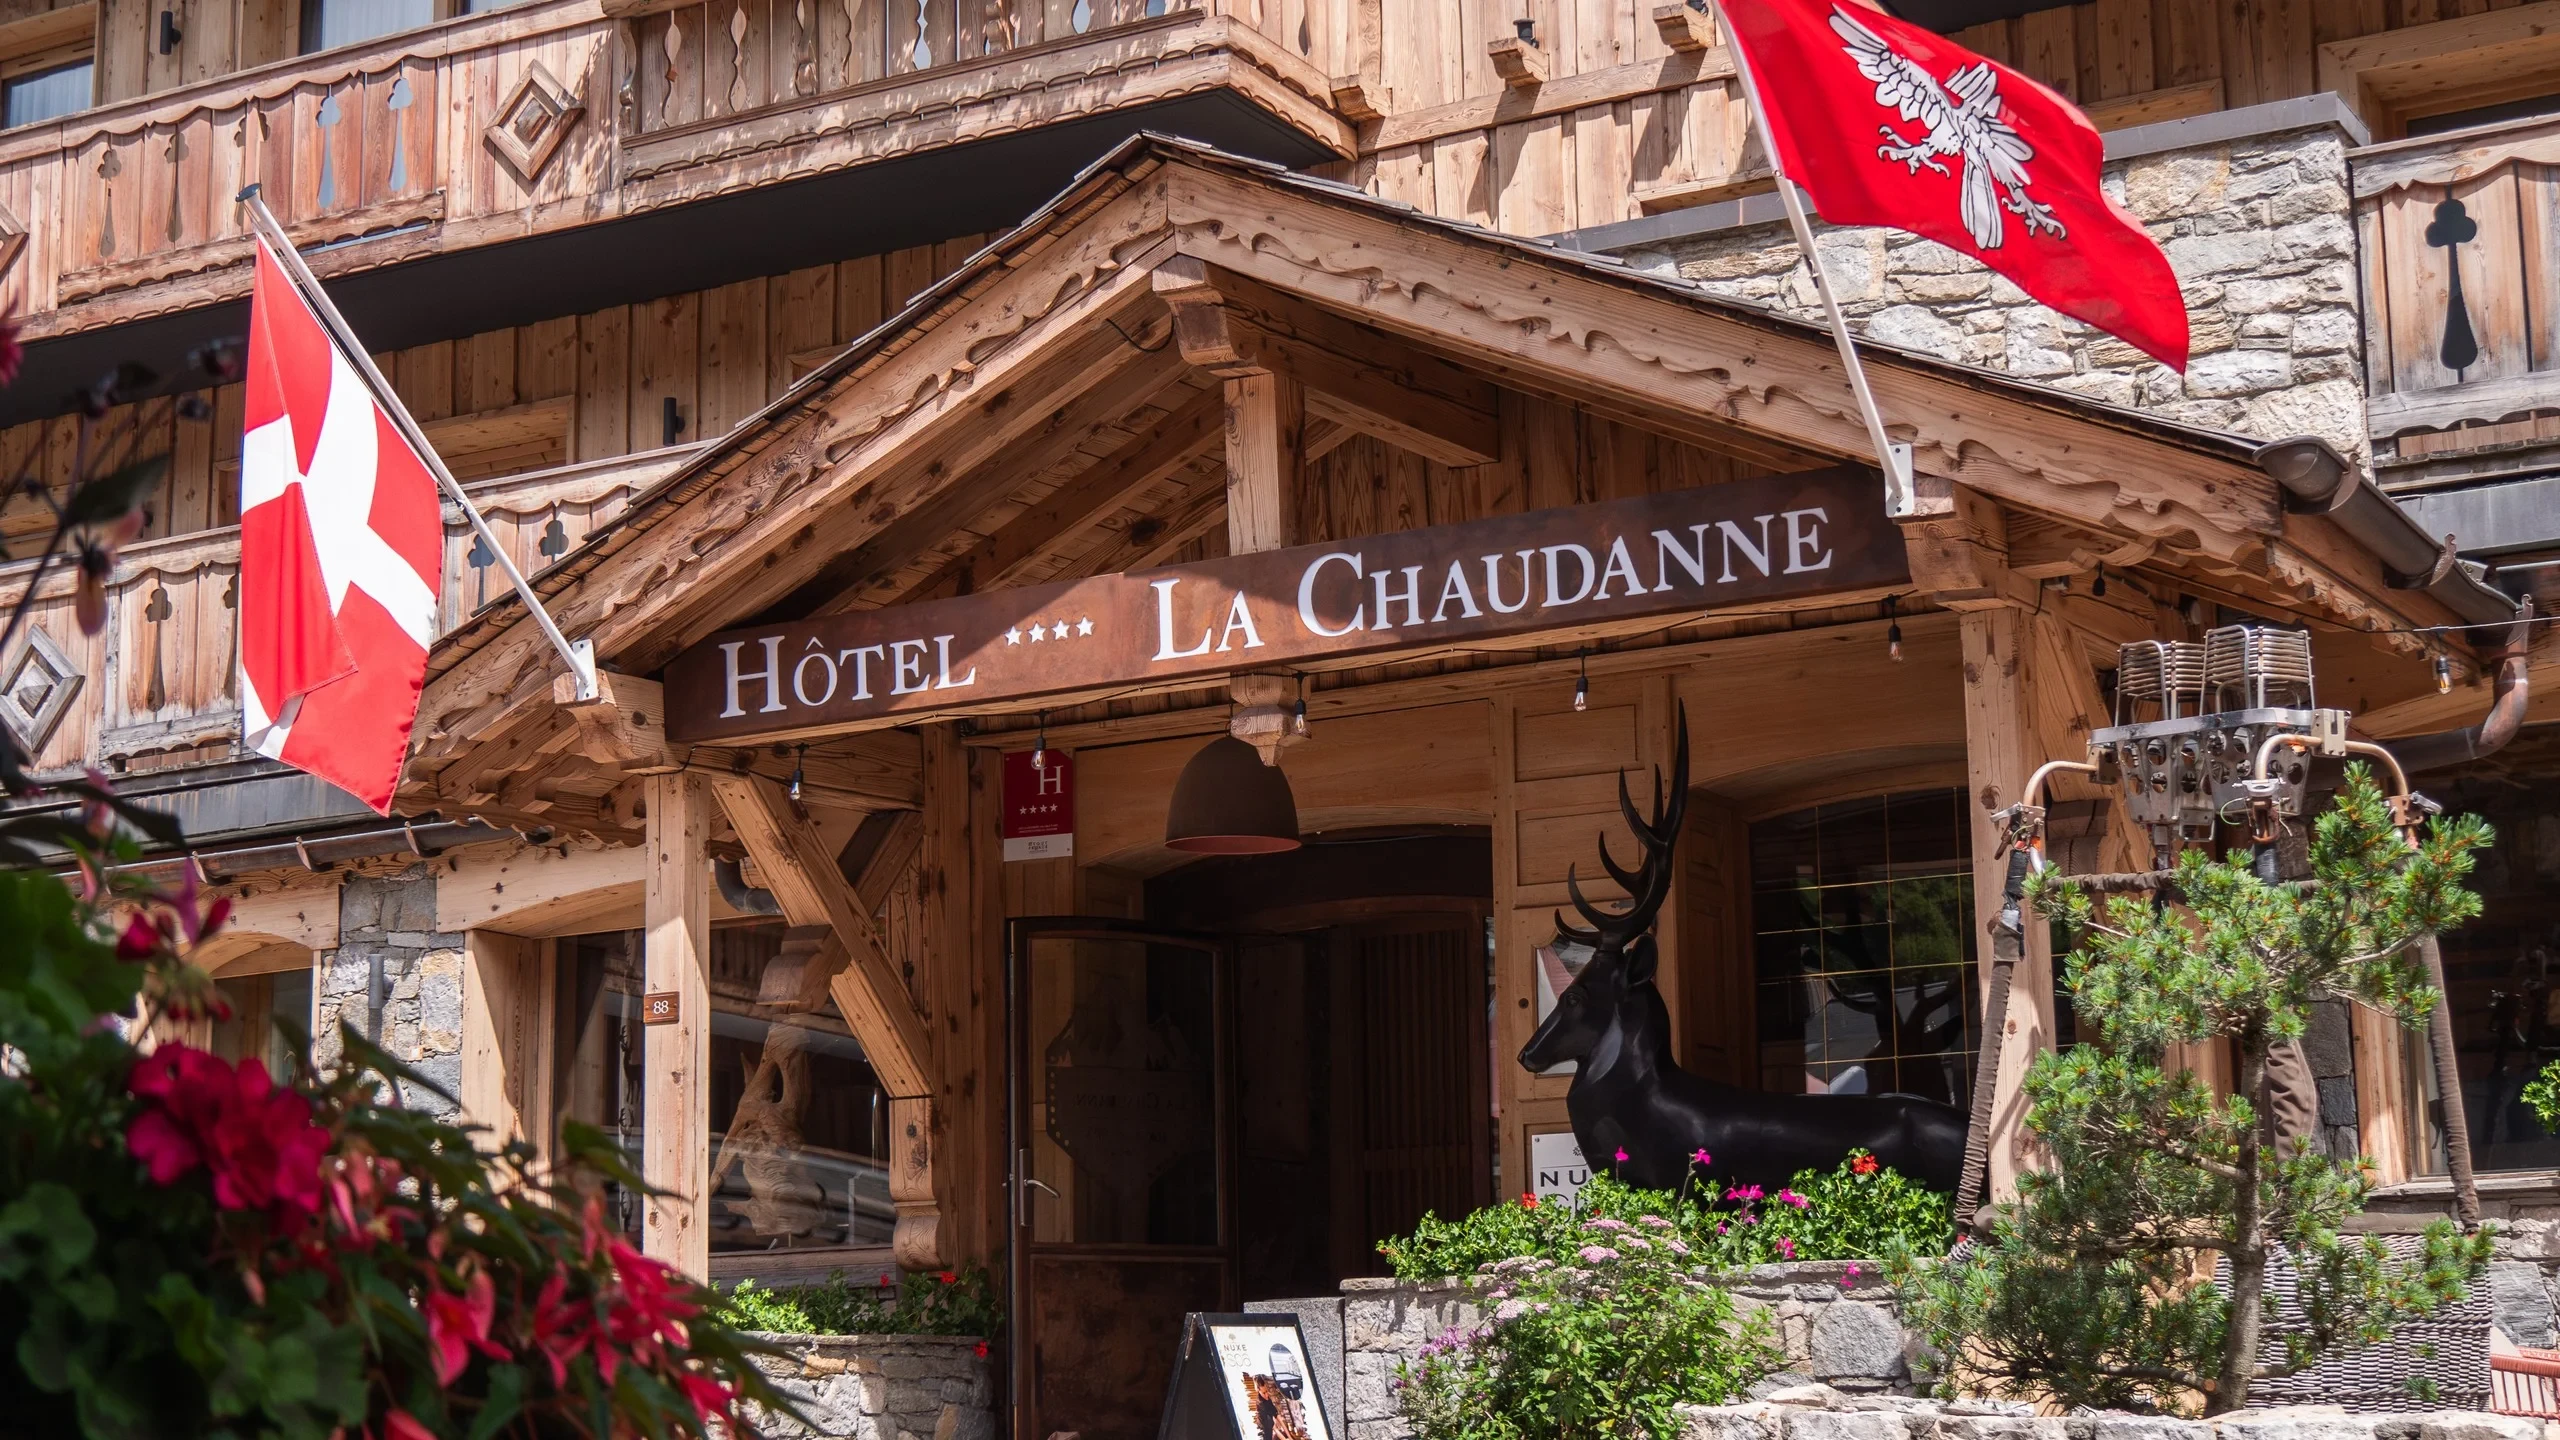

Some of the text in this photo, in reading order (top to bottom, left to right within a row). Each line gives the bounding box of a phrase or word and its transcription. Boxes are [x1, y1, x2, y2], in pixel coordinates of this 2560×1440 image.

[719, 507, 1833, 719] HÔTEL LA CHAUDANNE
[1037, 765, 1064, 795] H
[653, 1000, 669, 1015] 88
[1223, 1344, 1248, 1352] NUXE
